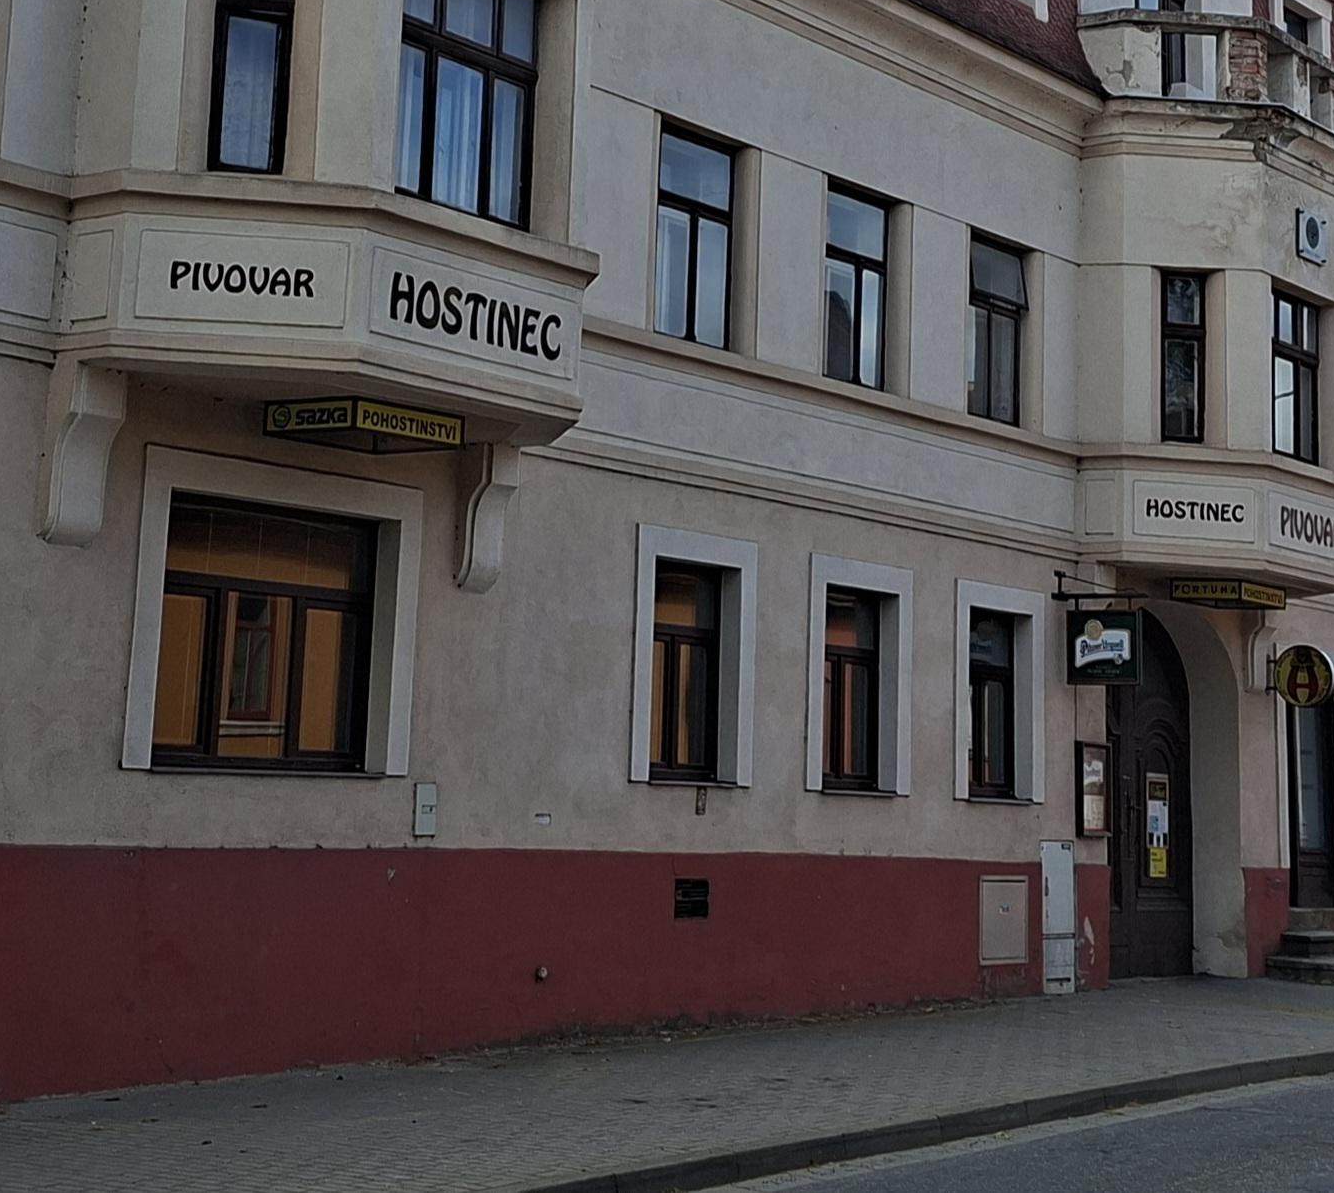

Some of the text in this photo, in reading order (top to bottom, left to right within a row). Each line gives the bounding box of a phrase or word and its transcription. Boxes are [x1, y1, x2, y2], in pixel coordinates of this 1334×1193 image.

[170, 260, 315, 298] PIVOVAR
[389, 271, 562, 361] HOSTINEC
[362, 410, 457, 440] POHOSTINSTVÍ
[1146, 499, 1245, 523] HOSTINEC
